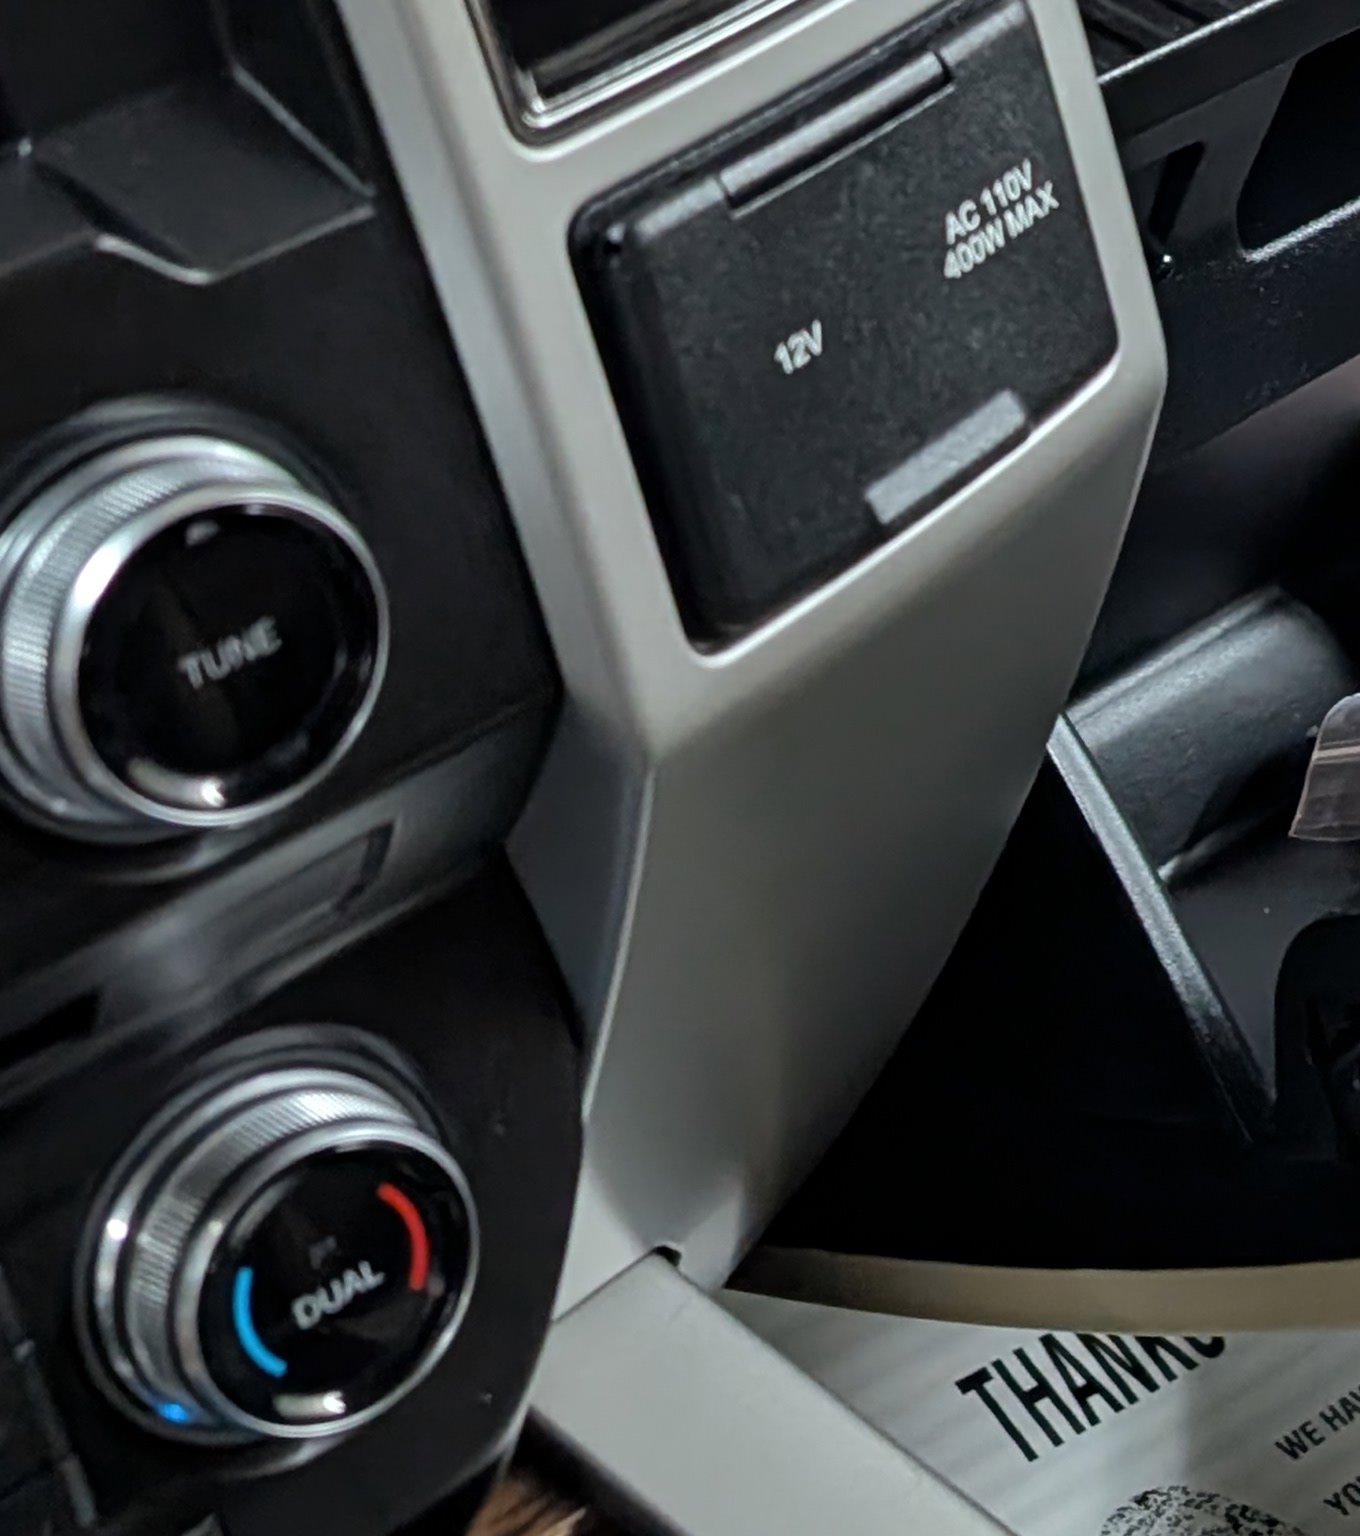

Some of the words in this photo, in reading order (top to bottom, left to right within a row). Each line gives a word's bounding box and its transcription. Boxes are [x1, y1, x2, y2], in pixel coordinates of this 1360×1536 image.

[944, 216, 1006, 279] 400W
[1003, 179, 1060, 239] MAX
[945, 211, 981, 245] AC
[980, 157, 1032, 216] 110V
[774, 319, 824, 374] 12V
[178, 615, 283, 689] TUNE
[291, 1260, 385, 1330] DUAL
[954, 1333, 1226, 1462] THANK
[1274, 1421, 1326, 1462] WE
